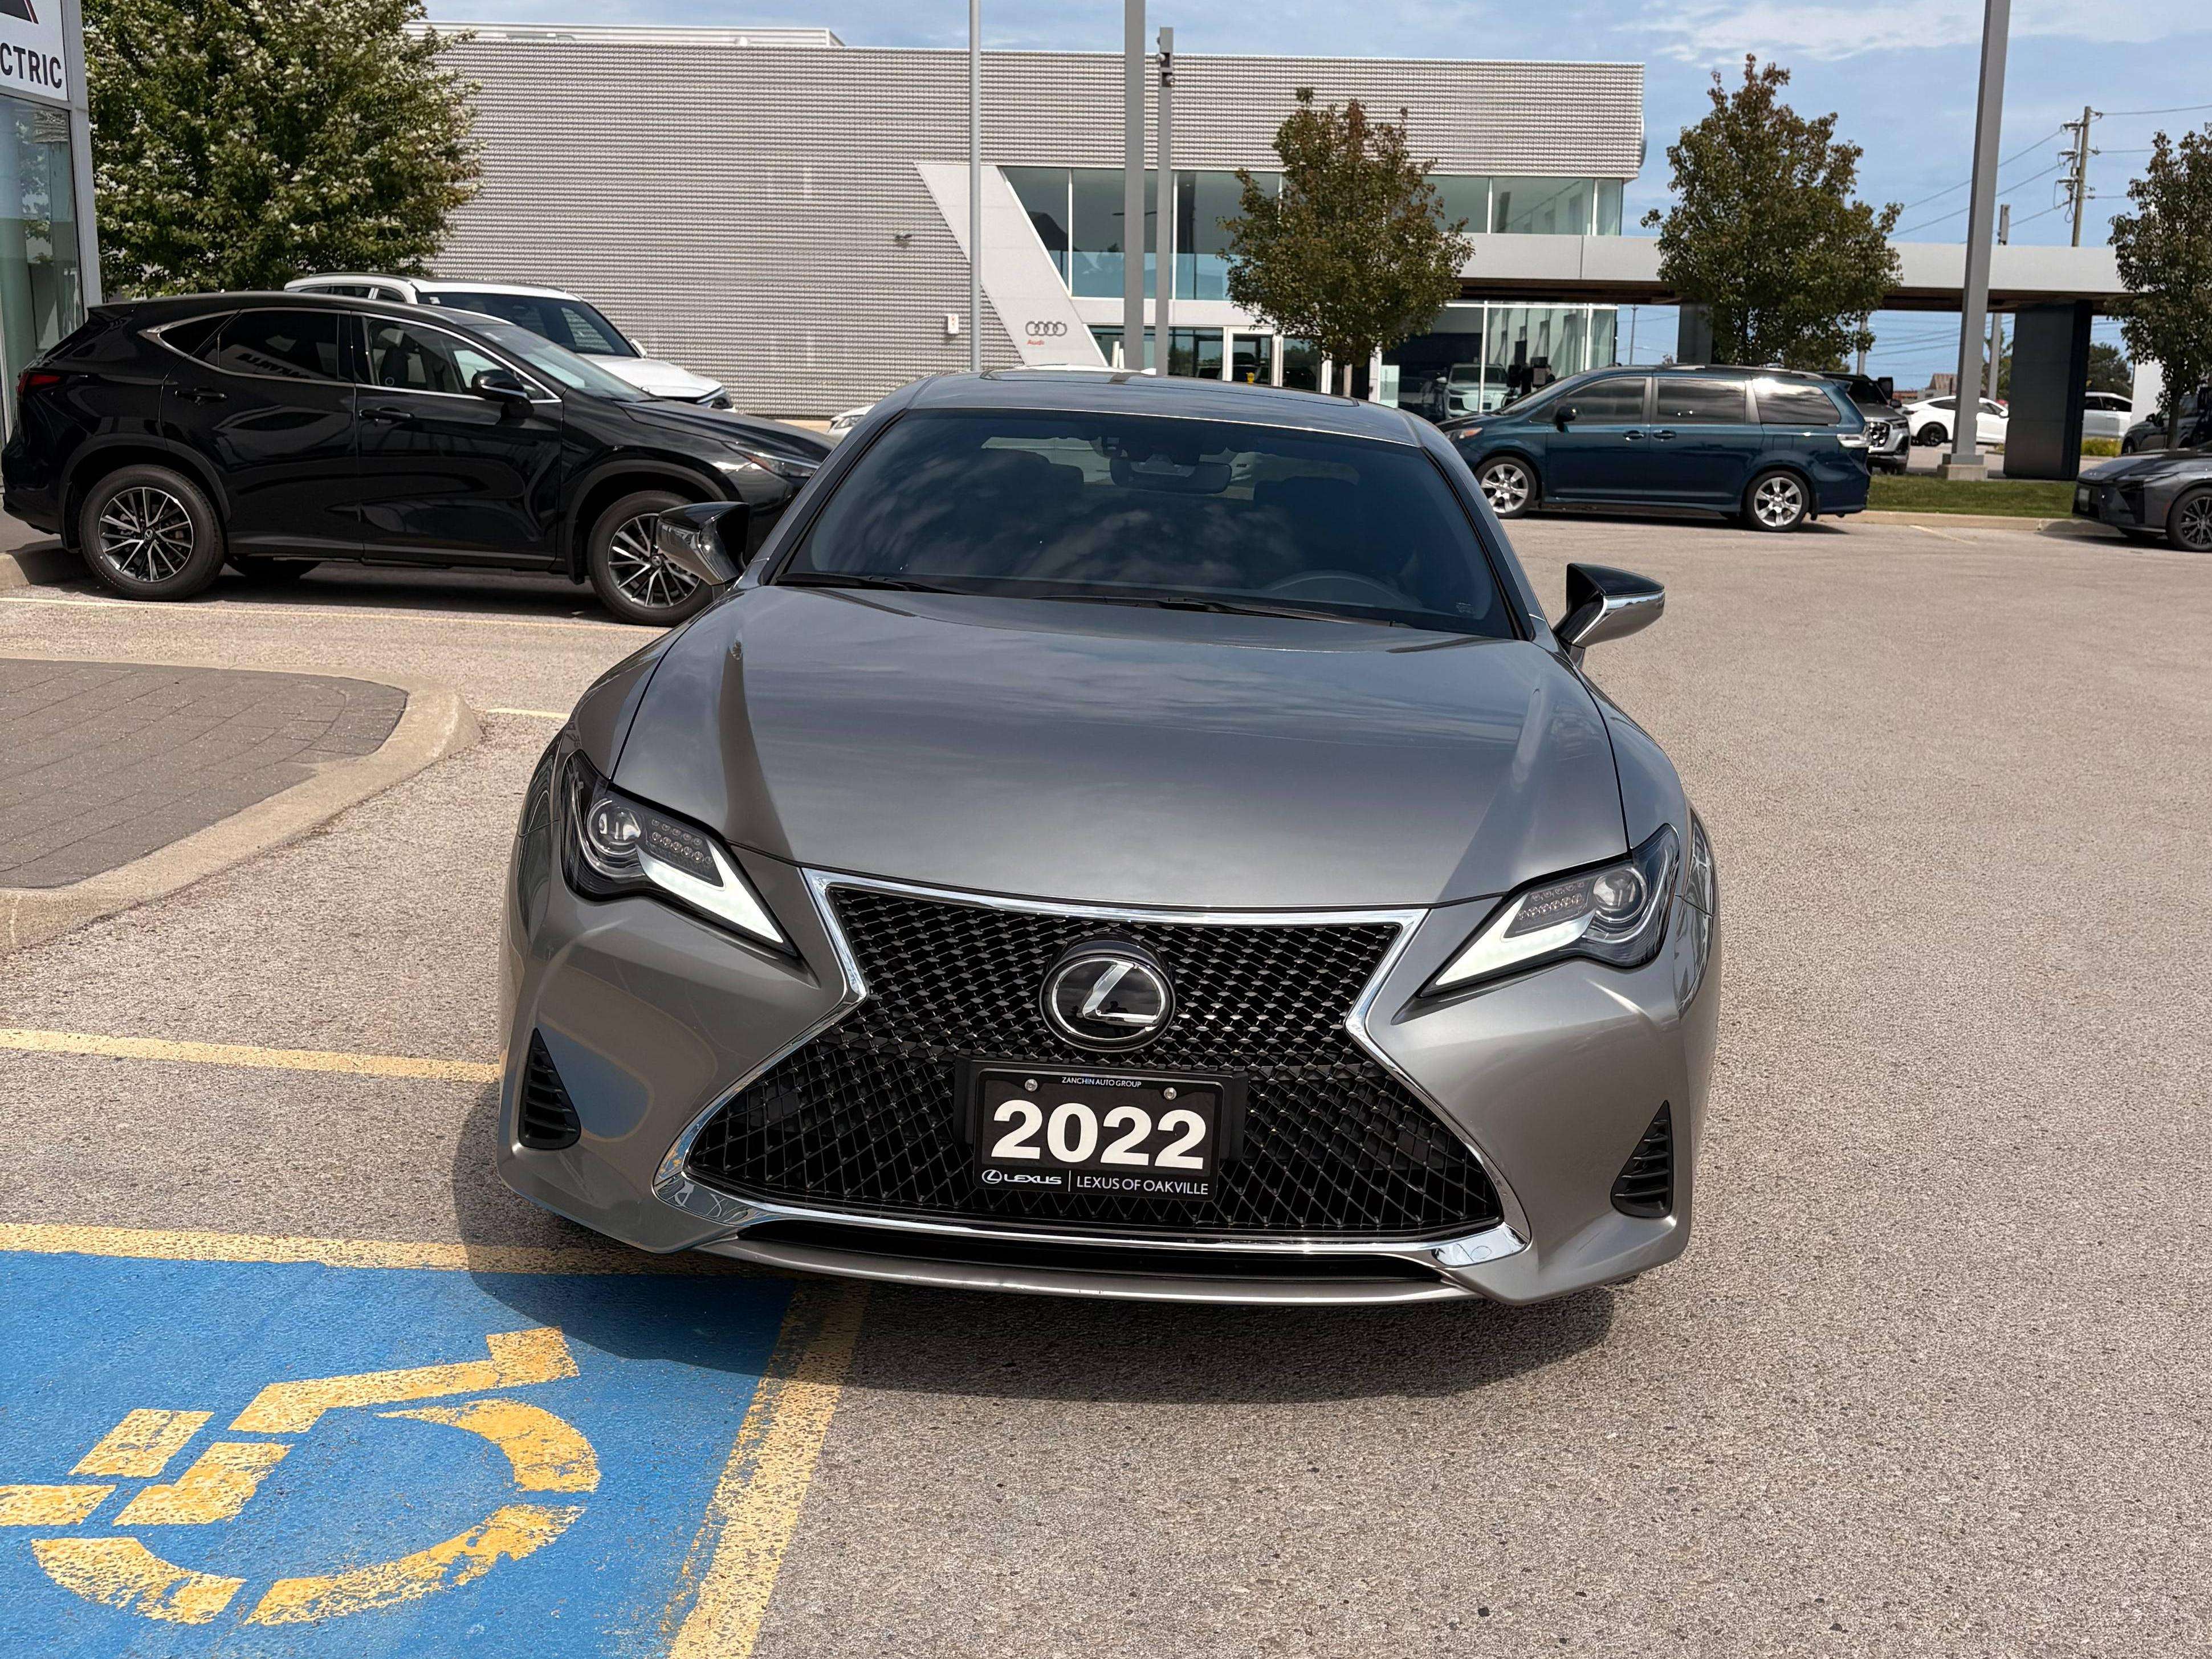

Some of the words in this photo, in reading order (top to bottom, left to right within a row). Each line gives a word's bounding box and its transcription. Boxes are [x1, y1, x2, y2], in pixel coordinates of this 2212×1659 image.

[0, 43, 62, 89] CTRIC
[991, 1099, 1206, 1169] 2022
[1004, 1173, 1062, 1184] LEXUS
[1077, 1176, 1119, 1189] LEXUS
[1122, 1179, 1141, 1191] OF
[1143, 1180, 1208, 1195] OAKVILLE
